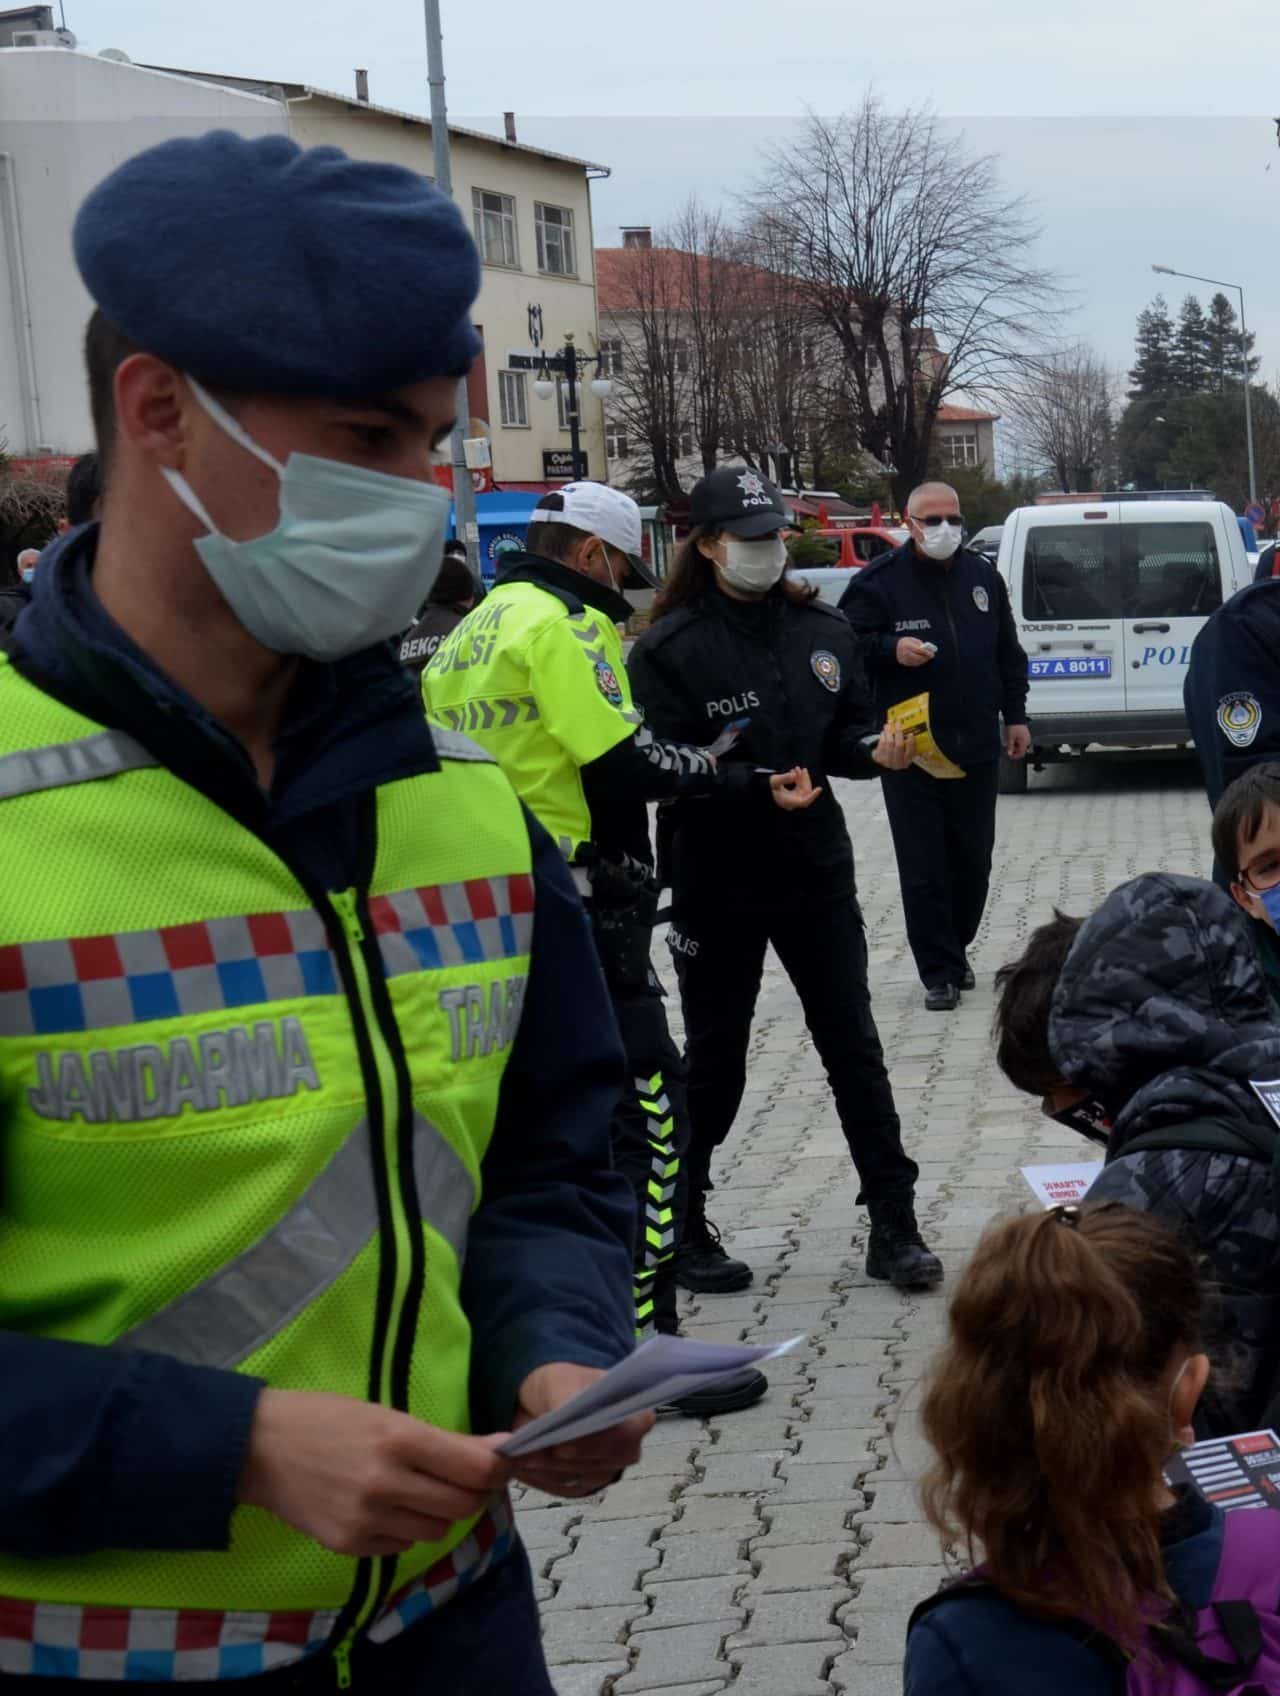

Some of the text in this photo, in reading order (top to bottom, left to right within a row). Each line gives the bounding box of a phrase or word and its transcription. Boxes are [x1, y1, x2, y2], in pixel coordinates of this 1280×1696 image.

[1031, 659, 1106, 674] 57 A 8011
[26, 1016, 322, 1123] JANDARMA
